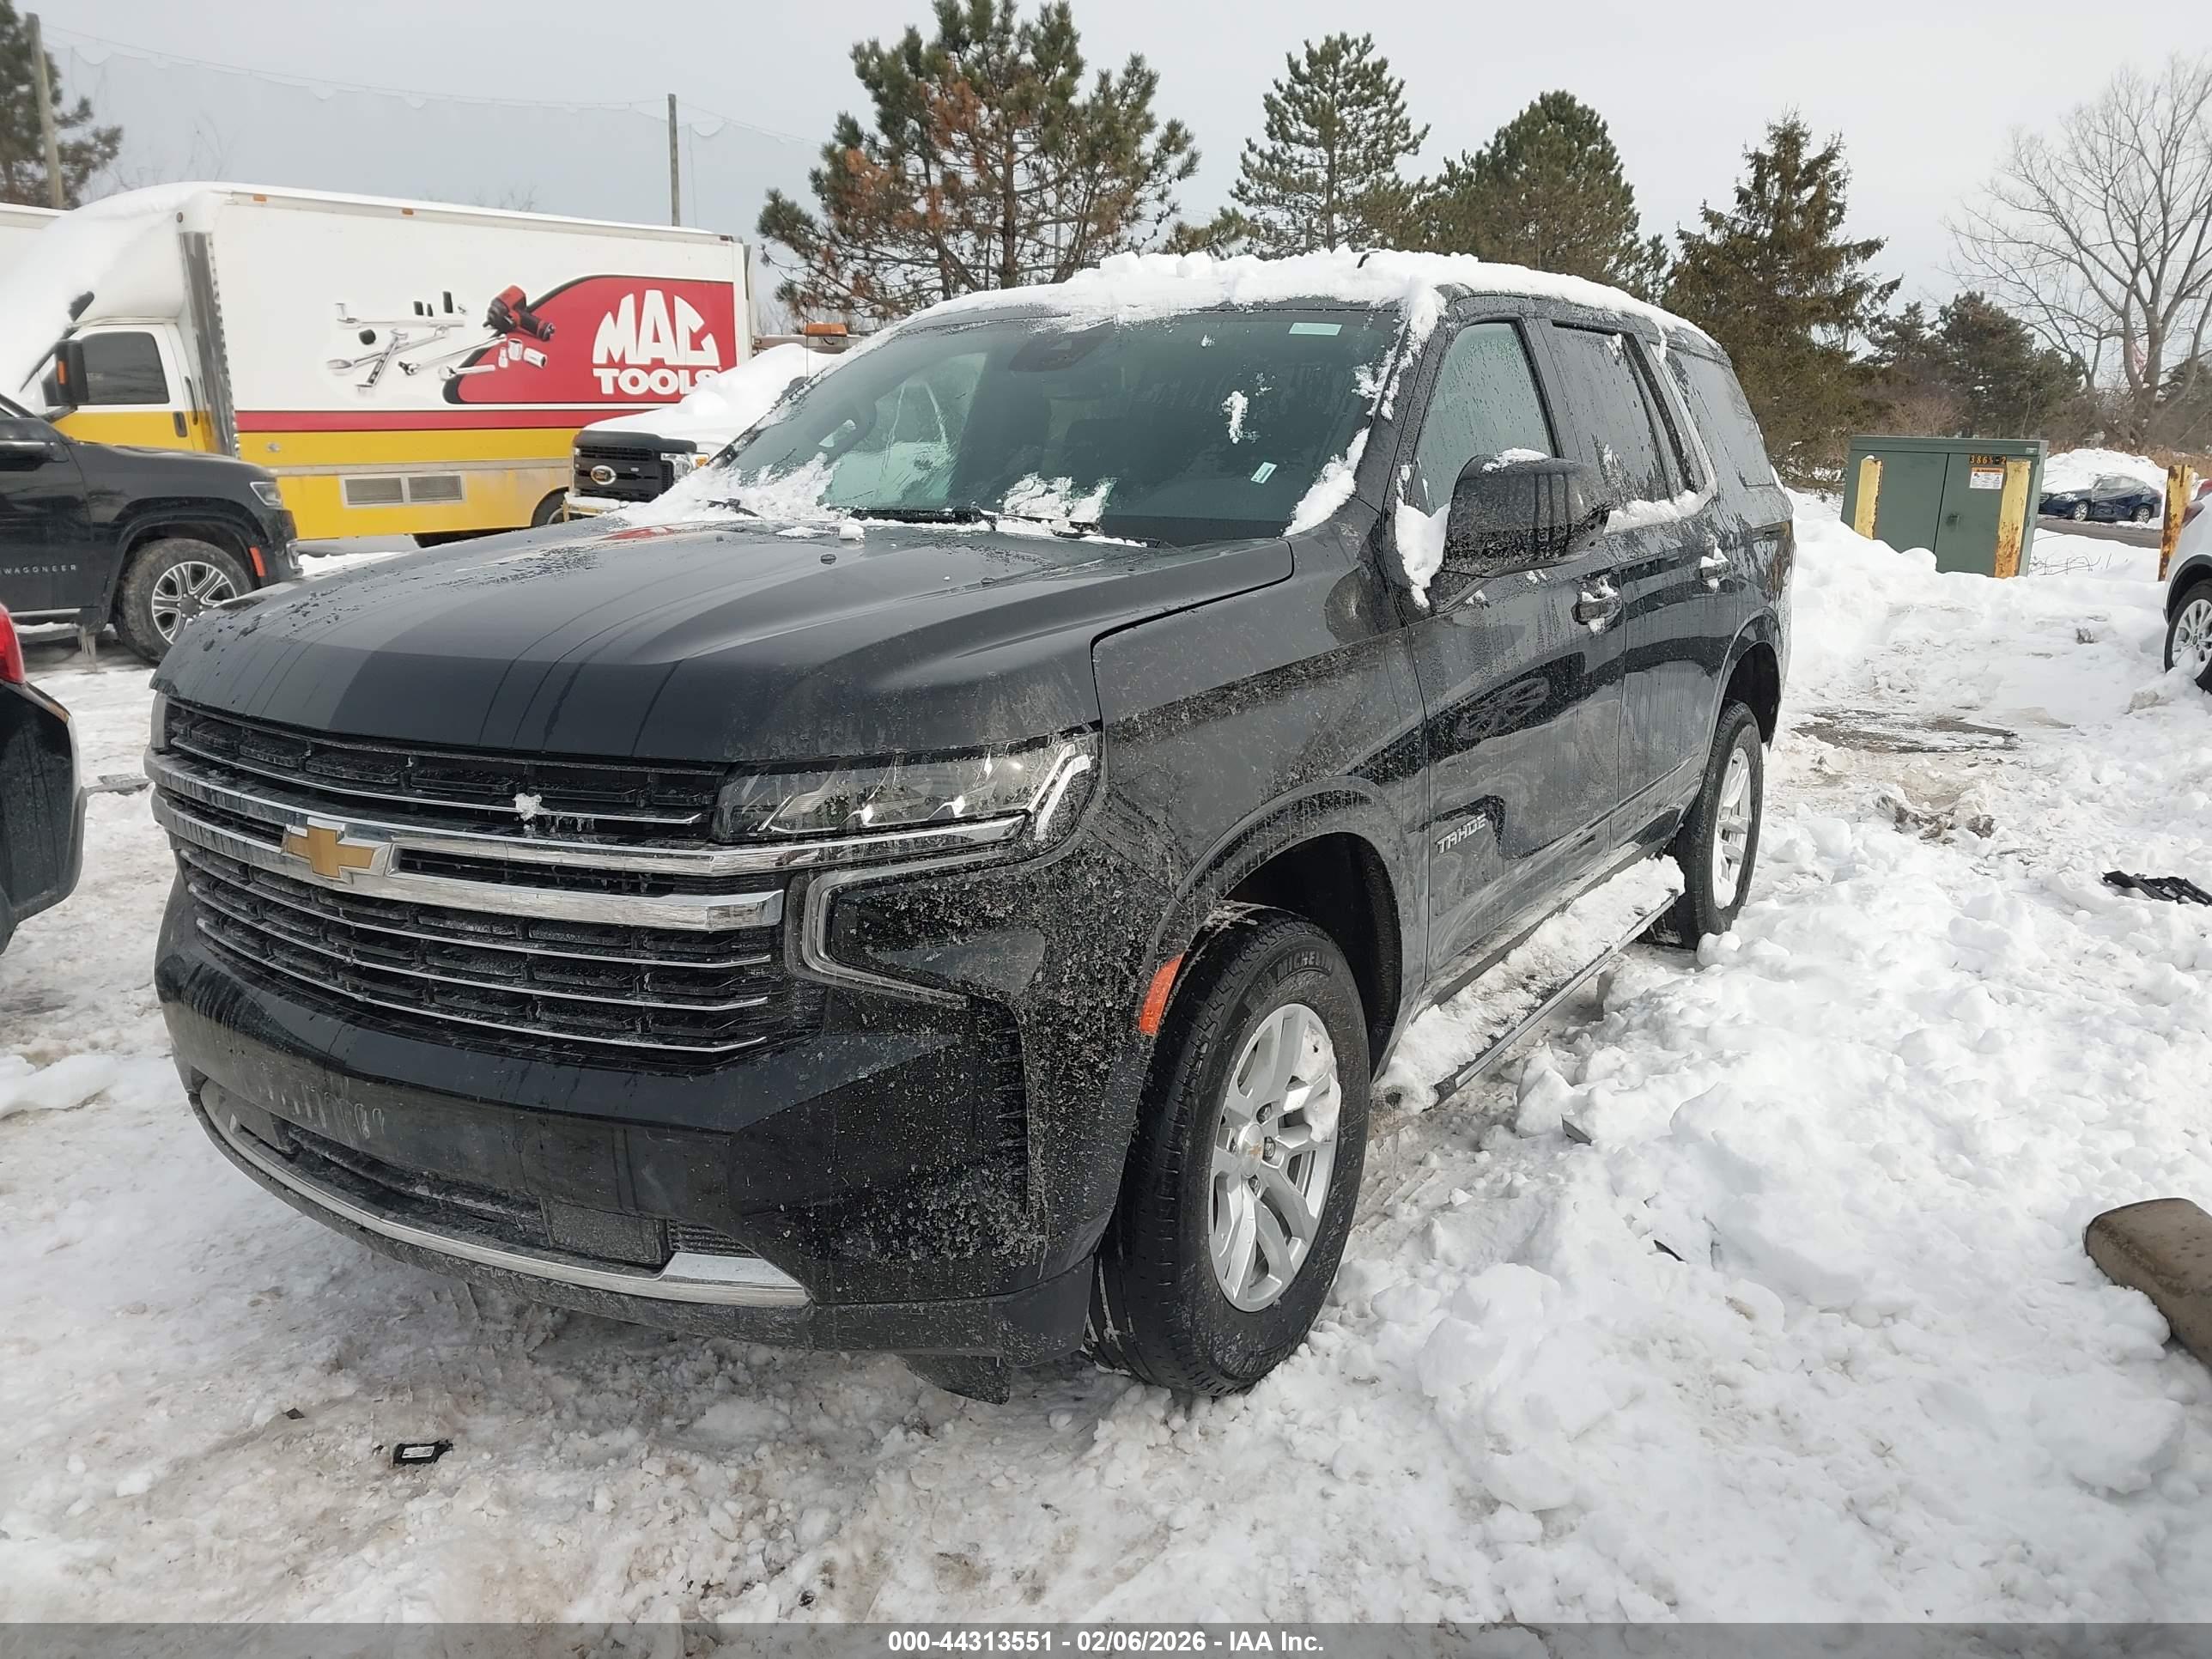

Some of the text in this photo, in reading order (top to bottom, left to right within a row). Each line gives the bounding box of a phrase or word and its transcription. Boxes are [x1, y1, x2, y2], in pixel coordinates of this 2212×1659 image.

[592, 289, 720, 367] MAC
[3, 563, 76, 574] WAGONEER
[1436, 812, 1488, 854] TAHOE
[1277, 950, 1333, 981] MICHELIN
